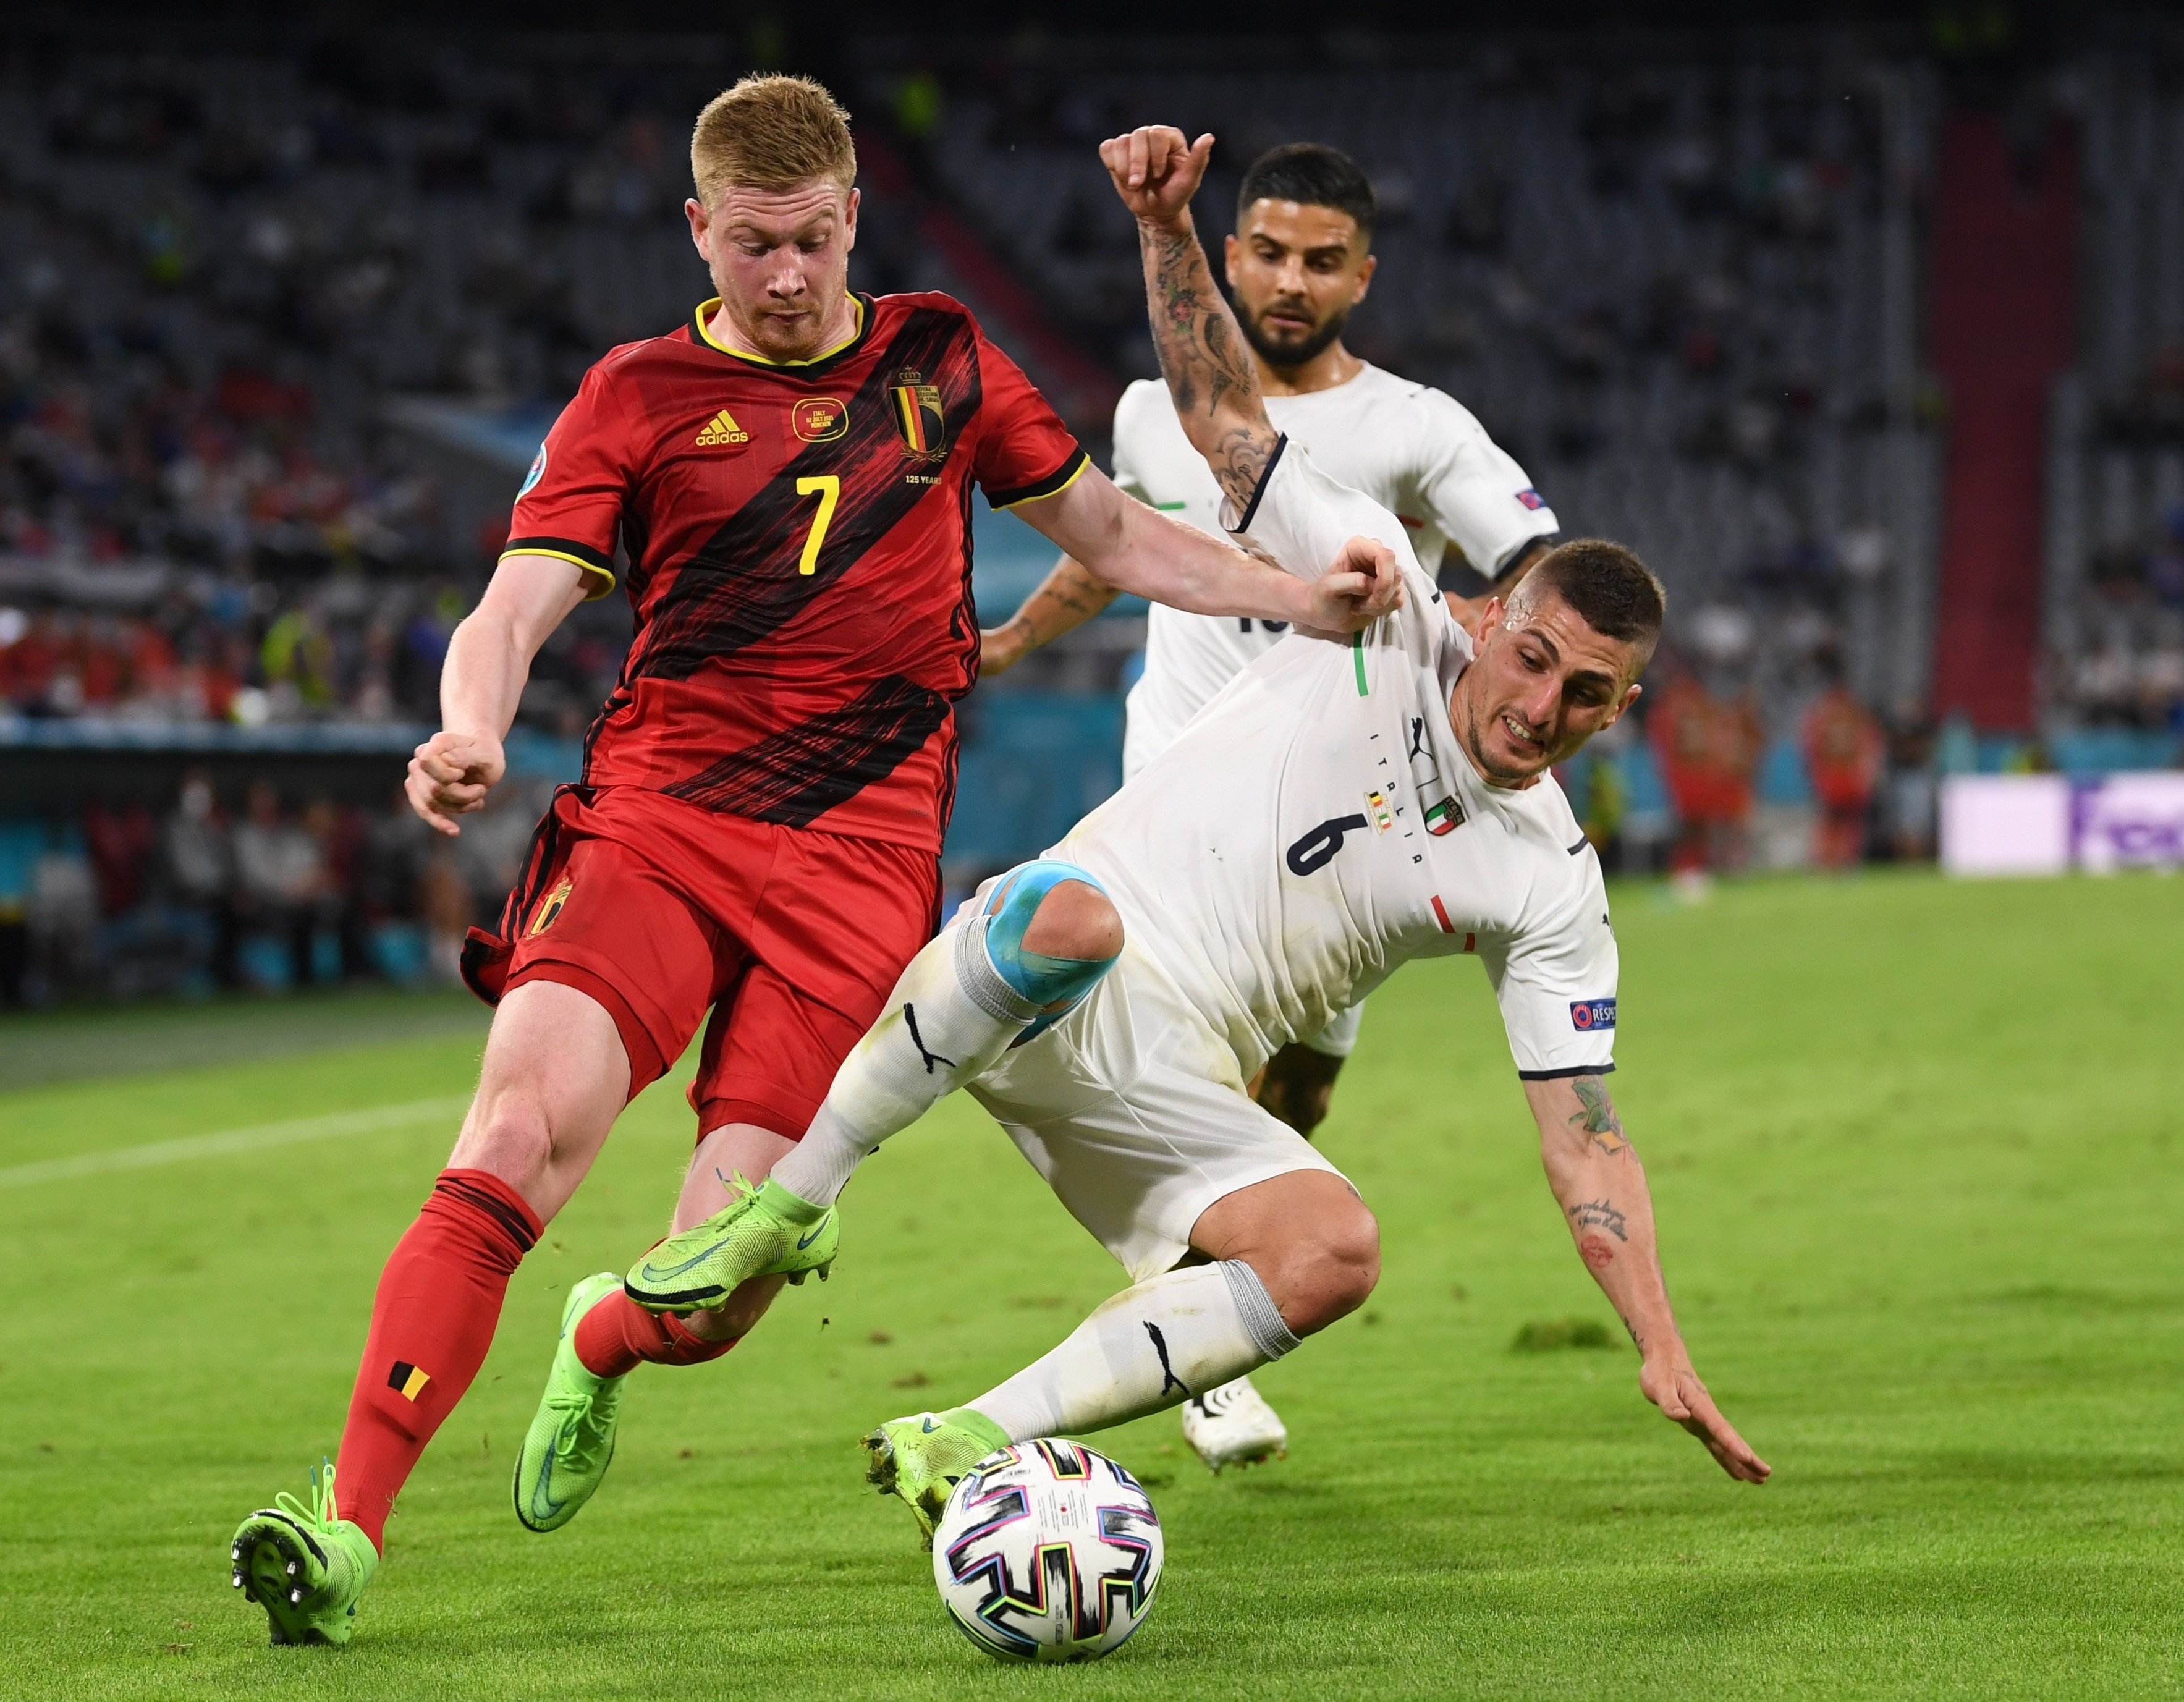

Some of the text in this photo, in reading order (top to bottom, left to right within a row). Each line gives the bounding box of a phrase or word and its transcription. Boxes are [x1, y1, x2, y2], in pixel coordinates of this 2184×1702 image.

[695, 431, 749, 446] adidas
[905, 475, 942, 485] 125 YEARS
[796, 475, 840, 575] 7
[1286, 813, 1368, 876] 6
